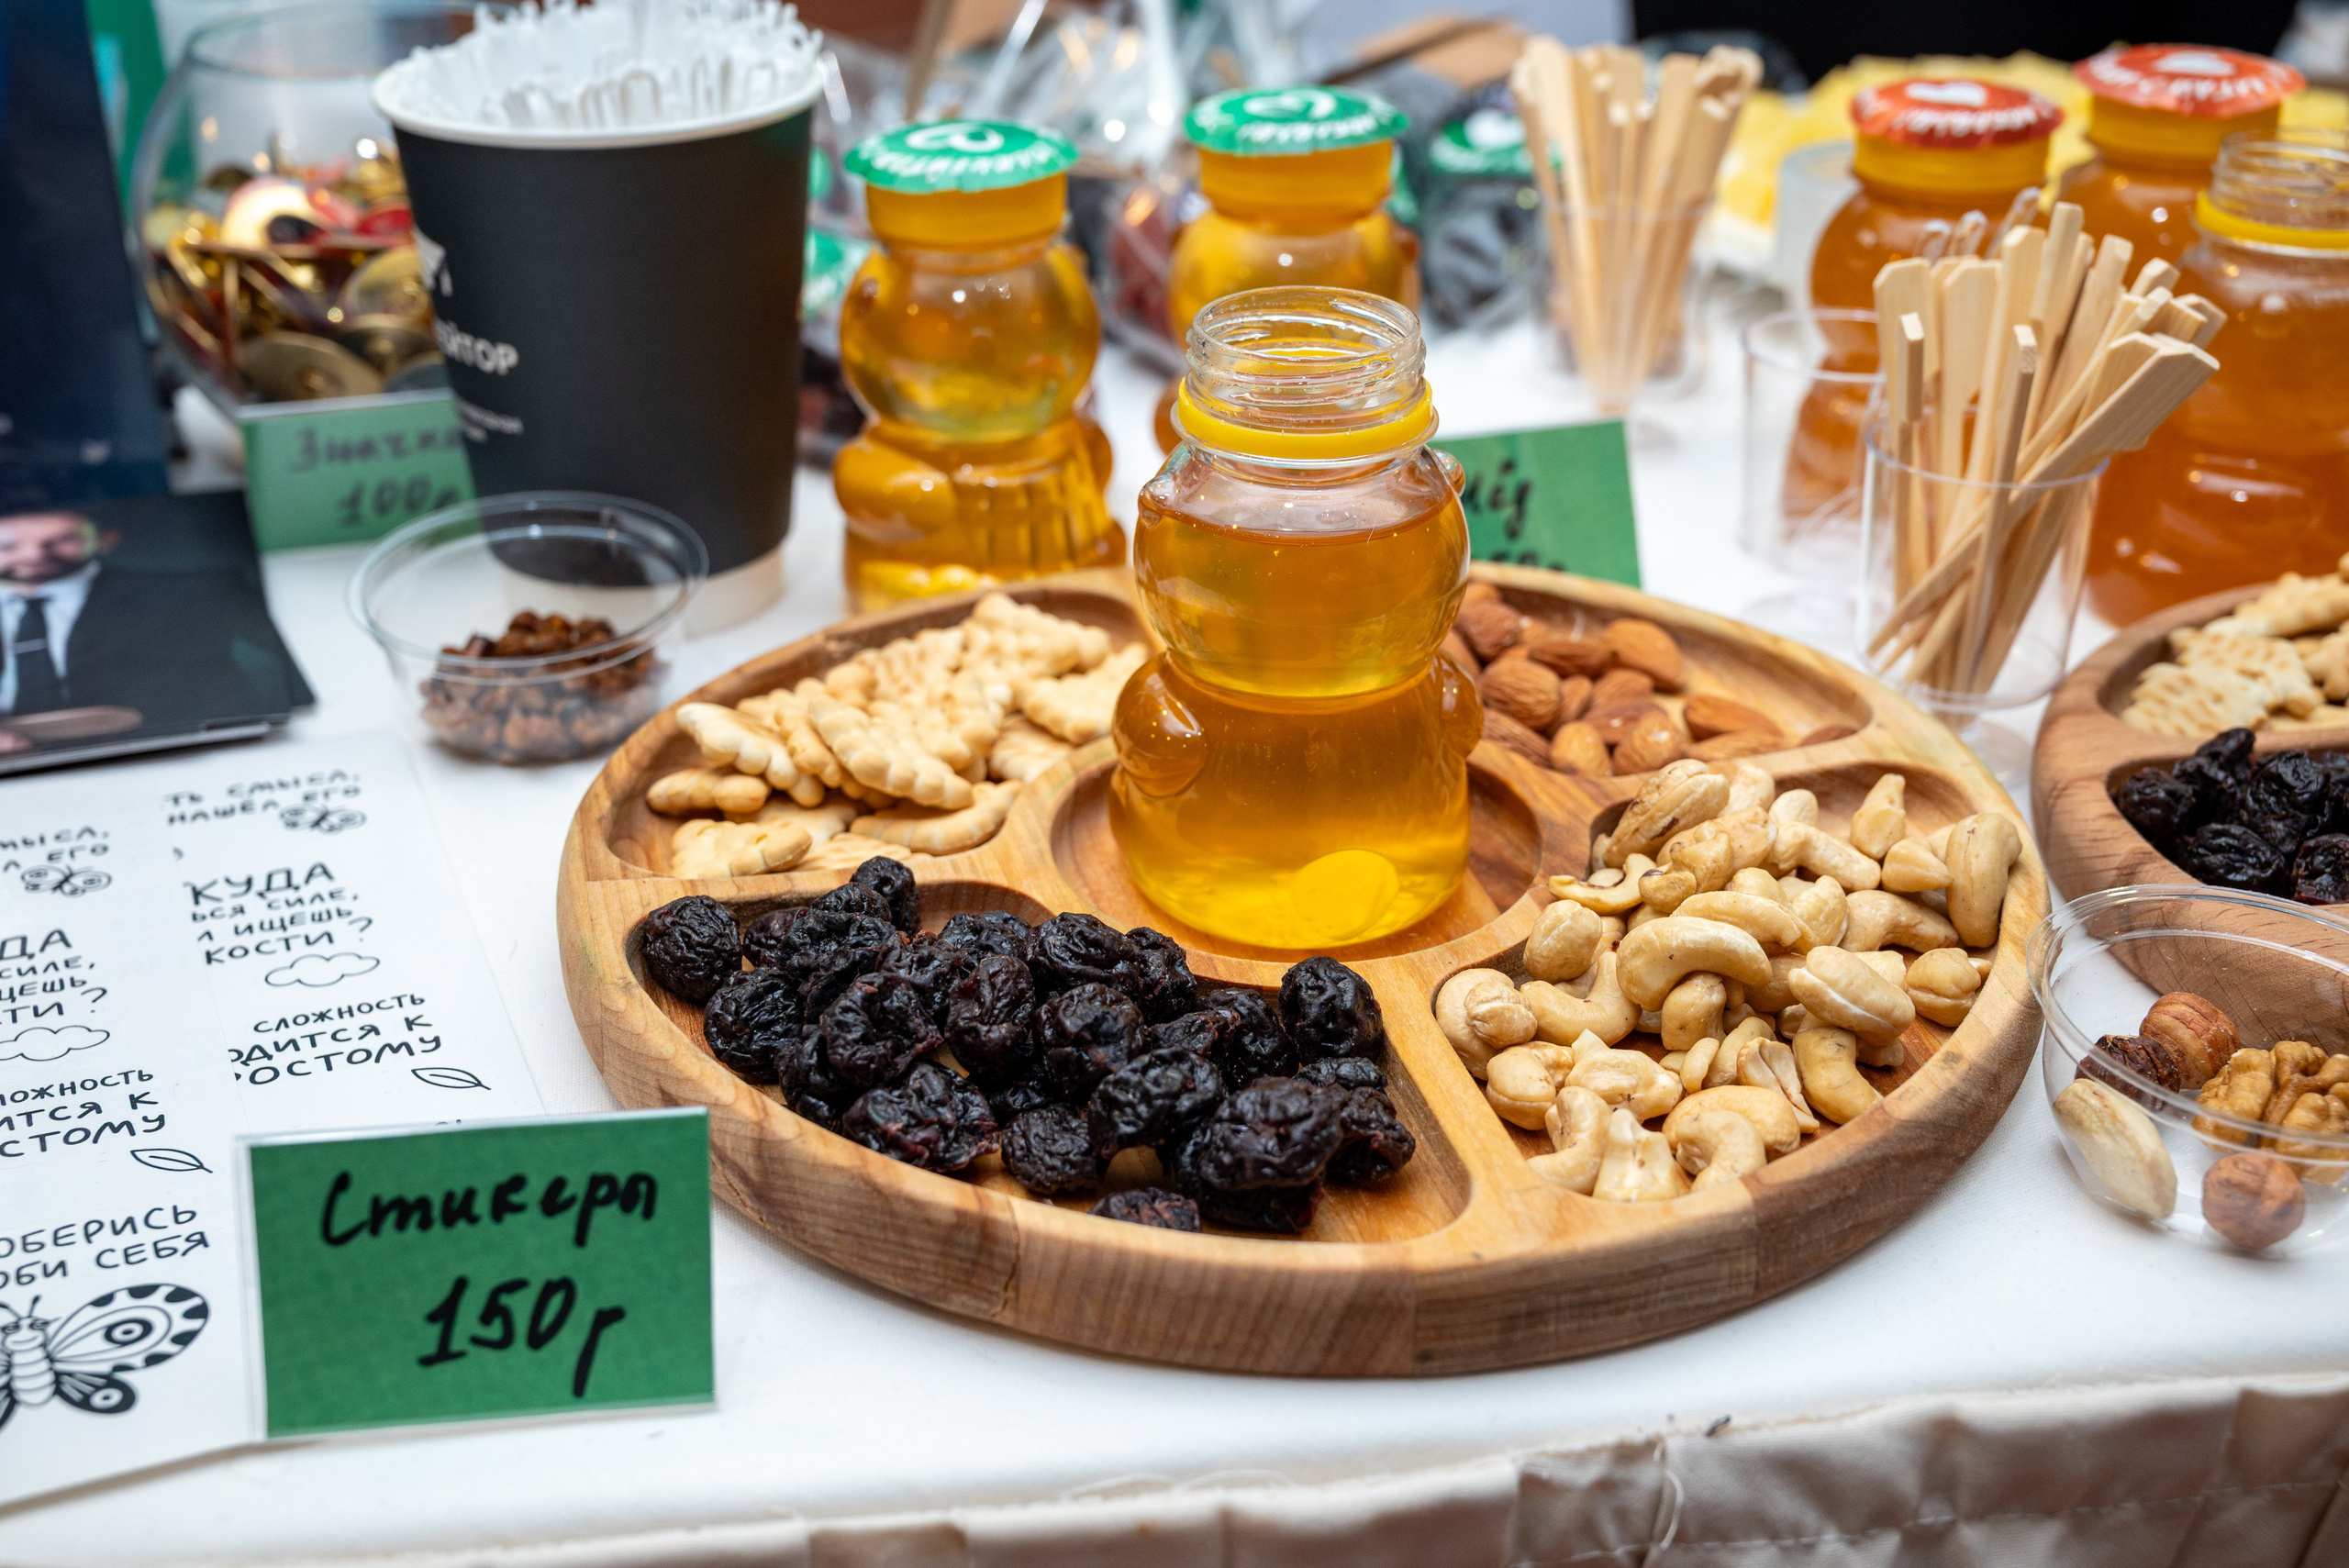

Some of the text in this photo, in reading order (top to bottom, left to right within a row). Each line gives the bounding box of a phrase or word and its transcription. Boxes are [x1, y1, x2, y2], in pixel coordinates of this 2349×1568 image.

[186, 861, 336, 906] КУДА
[266, 886, 360, 911] СИЛЕ,
[233, 906, 354, 938] ИЩЕШЬ
[204, 929, 335, 966] КОСТИ
[253, 993, 427, 1033] СЛОЖНОСТЬ
[233, 1035, 442, 1086] ОСТОМУ
[95, 1230, 210, 1269] СЕБЯ
